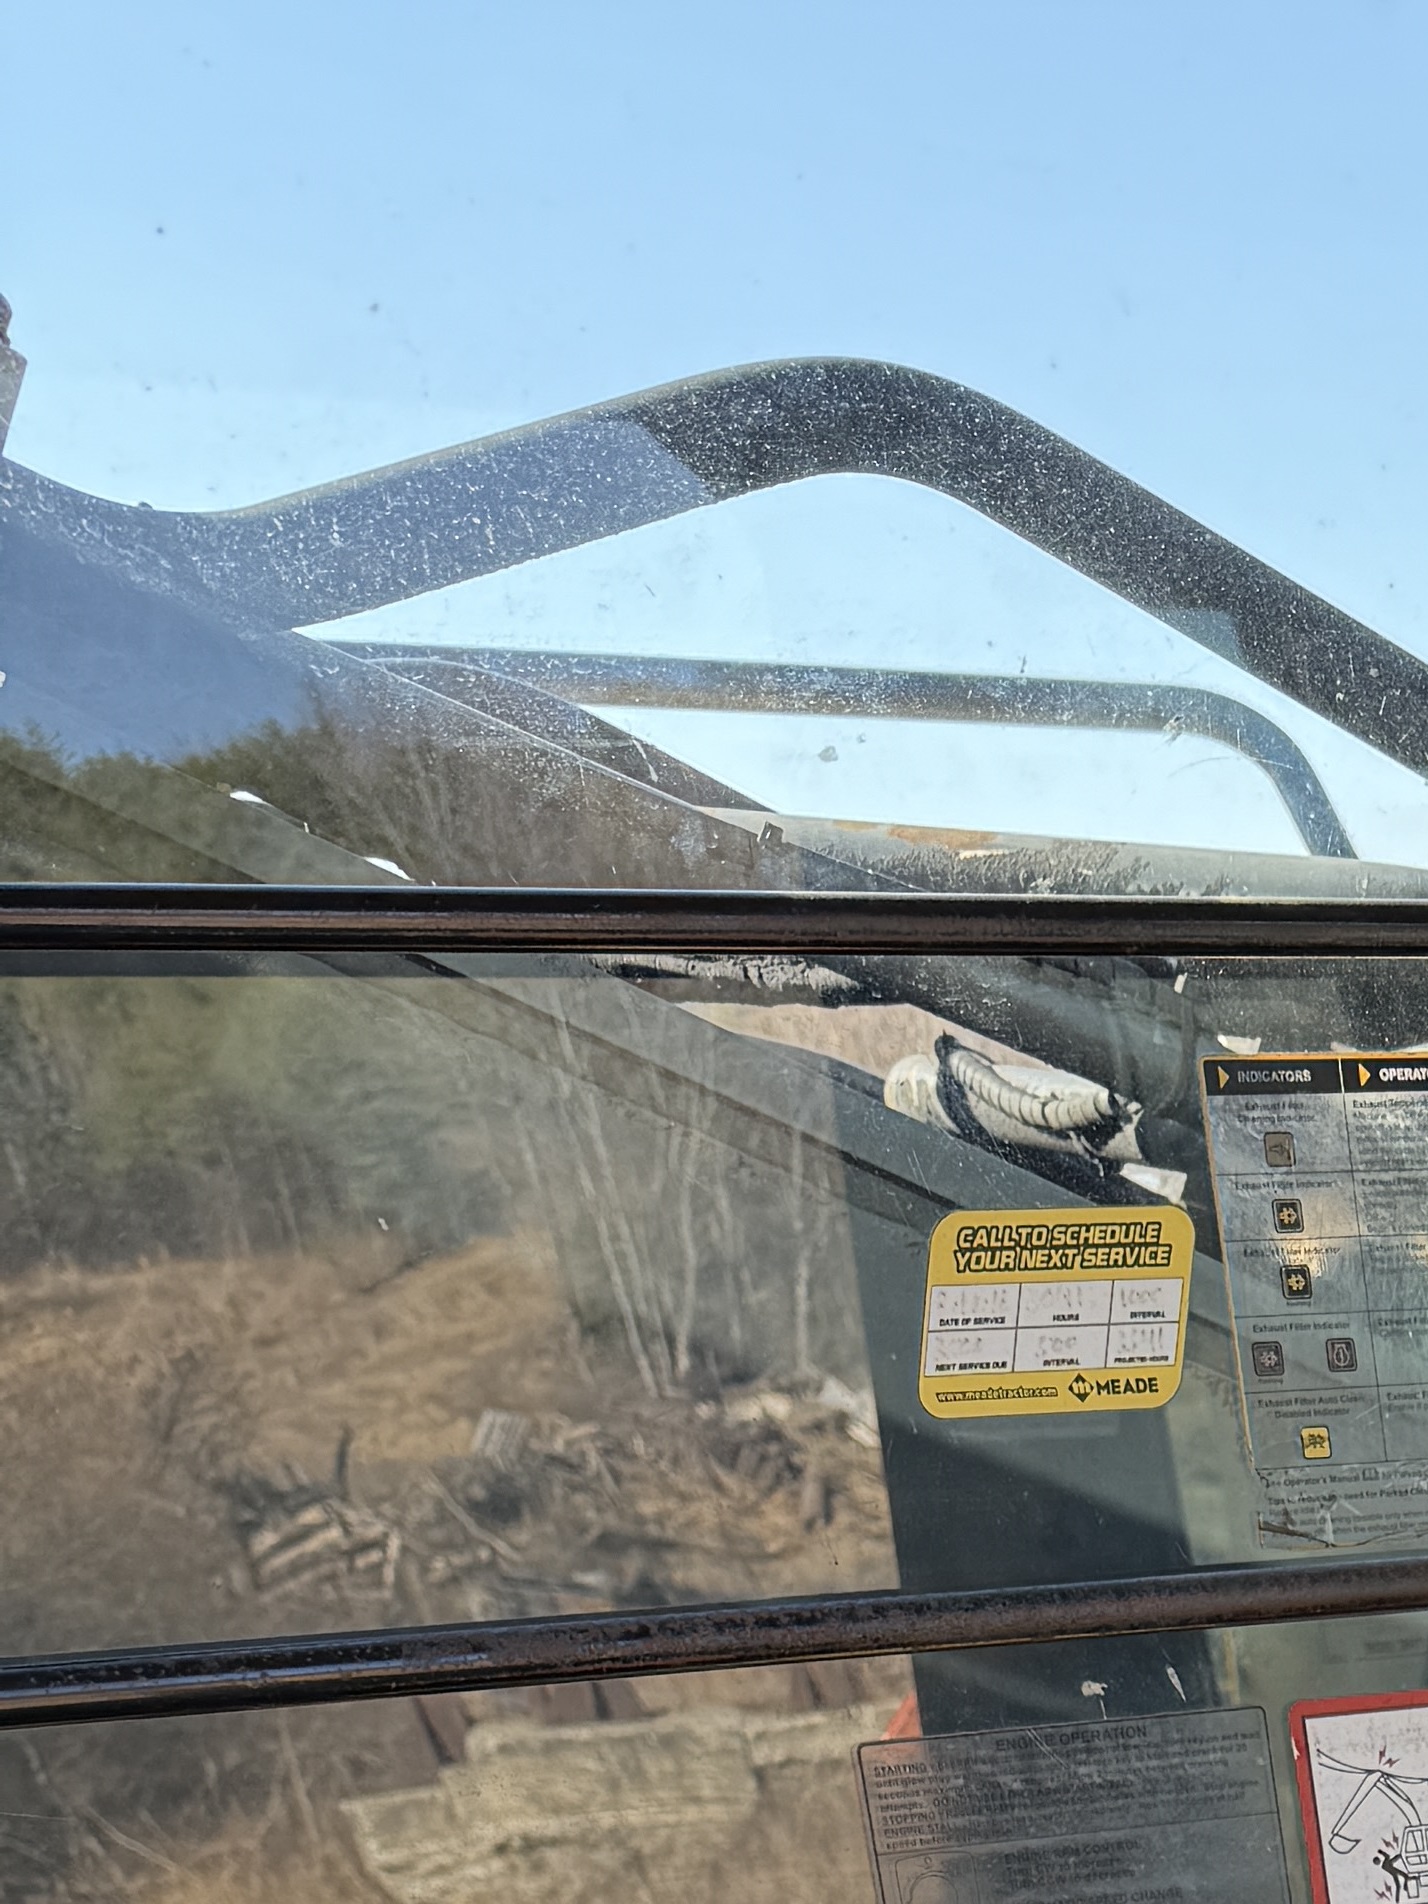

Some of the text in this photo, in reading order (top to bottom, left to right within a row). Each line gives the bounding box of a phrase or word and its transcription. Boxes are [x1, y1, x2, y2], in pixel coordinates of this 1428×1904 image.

[1237, 1069, 1311, 1083] INDICATORS
[958, 1223, 1160, 1249] CALL TO SCHEDULE
[955, 1245, 1171, 1271] YOUR NEXT SERVICE
[939, 1316, 1005, 1326] DATE OF SERVICE
[1095, 1377, 1159, 1395] MEADE
[1058, 1724, 1148, 1746] OPERATION
